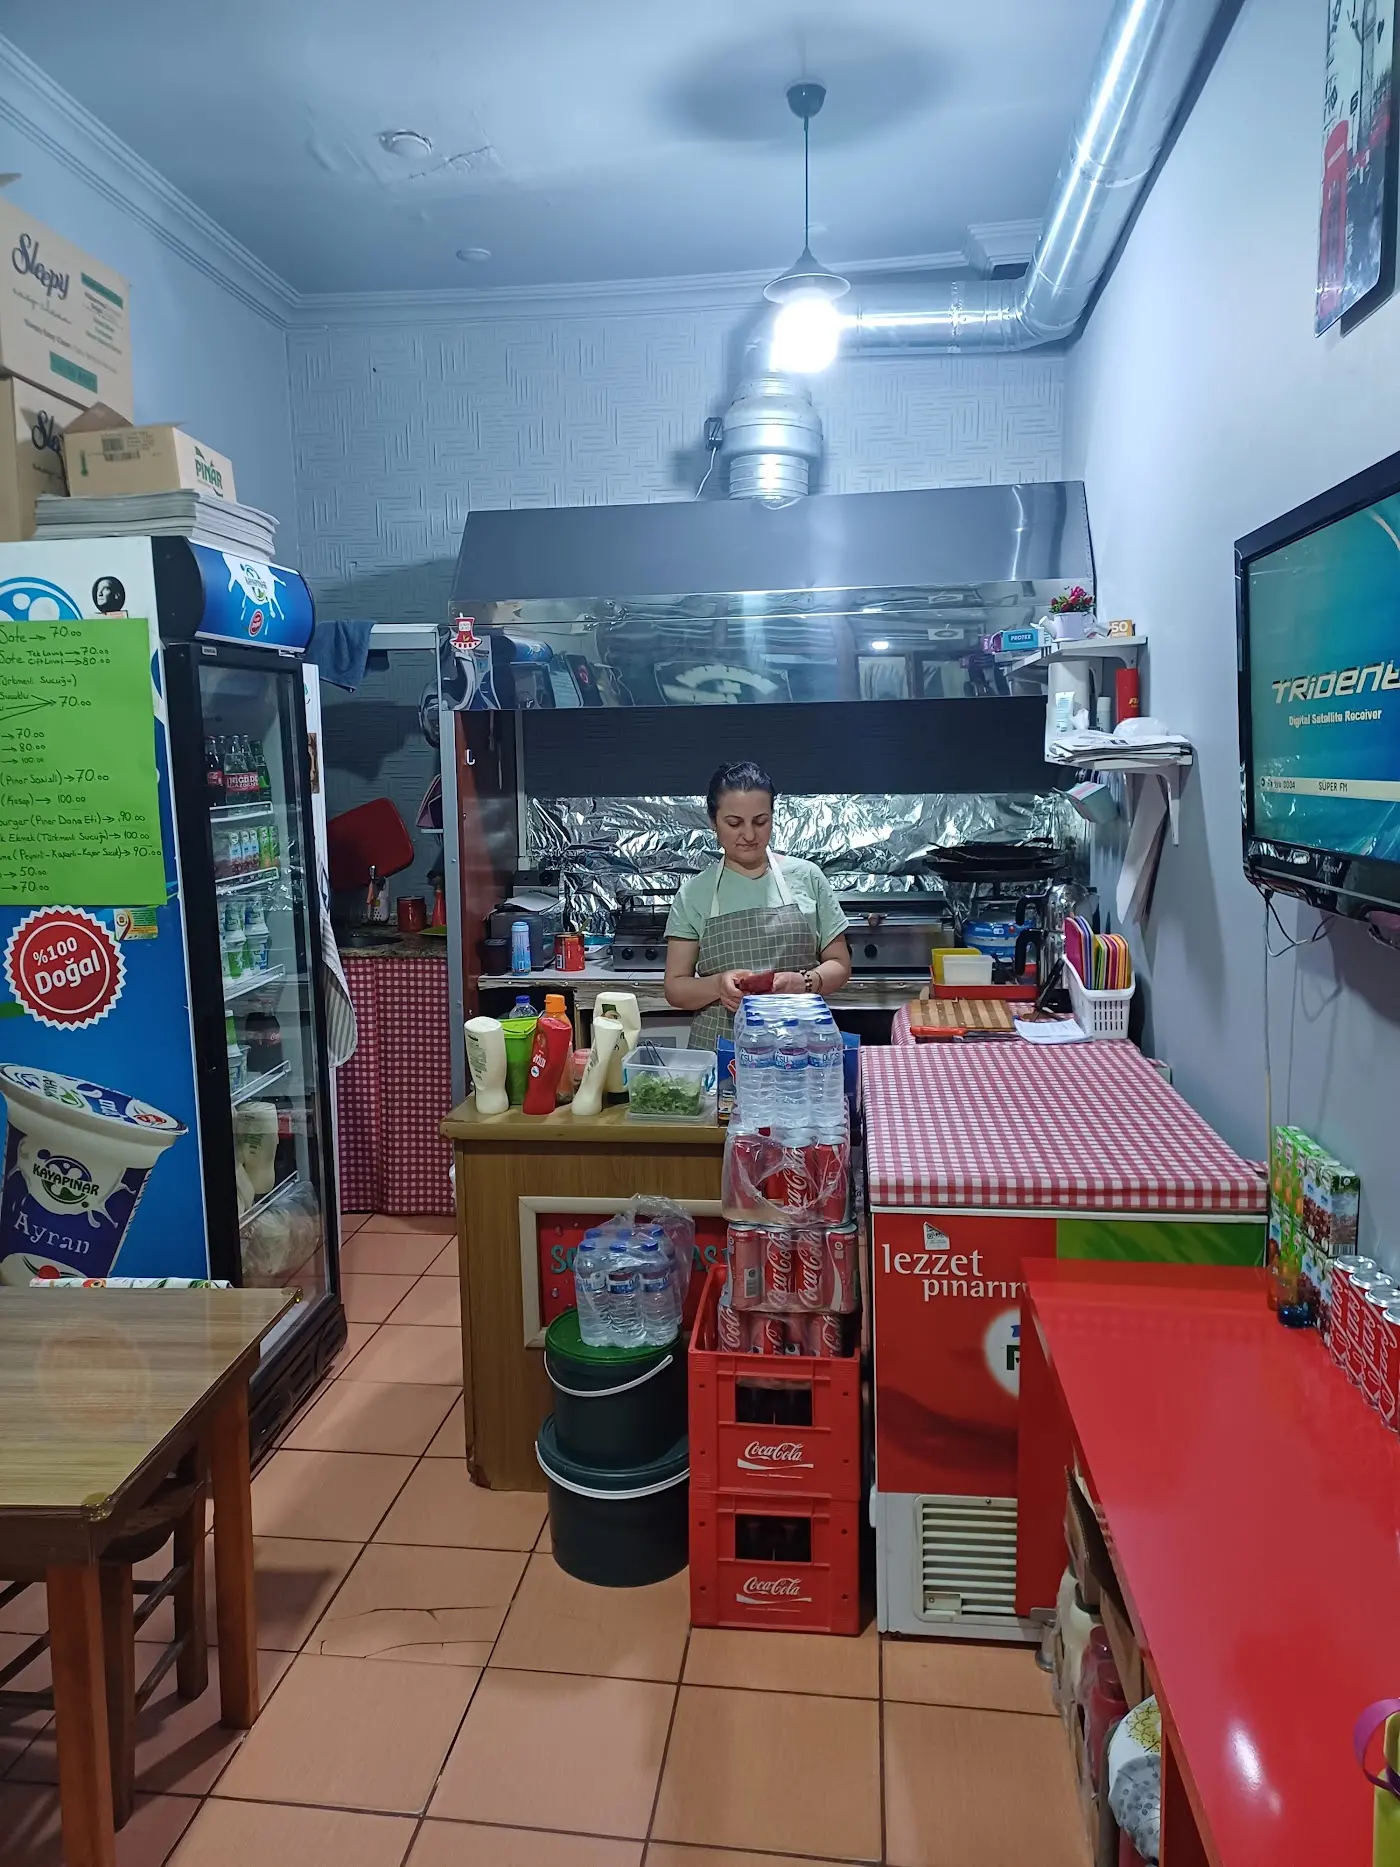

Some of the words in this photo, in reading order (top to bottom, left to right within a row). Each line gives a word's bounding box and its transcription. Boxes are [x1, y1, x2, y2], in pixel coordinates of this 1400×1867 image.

[12, 233, 70, 300] Sleepy
[1010, 633, 1032, 641] PROTEX
[1111, 621, 1129, 633] 50
[1288, 713, 1311, 728] Digital
[1312, 713, 1343, 724] Satellite
[1344, 708, 1383, 721] Receiver
[75, 768, 110, 783] 70.00
[1339, 782, 1348, 792] FM
[32, 936, 79, 967] %100
[33, 949, 101, 995] Doğal
[32, 1163, 100, 1197] KAYAPINAR
[14, 1210, 90, 1255] Ayran
[881, 1243, 984, 1277] lezzet
[744, 1440, 806, 1462] Coca-Cola
[743, 1576, 802, 1596] Coca-Cola
